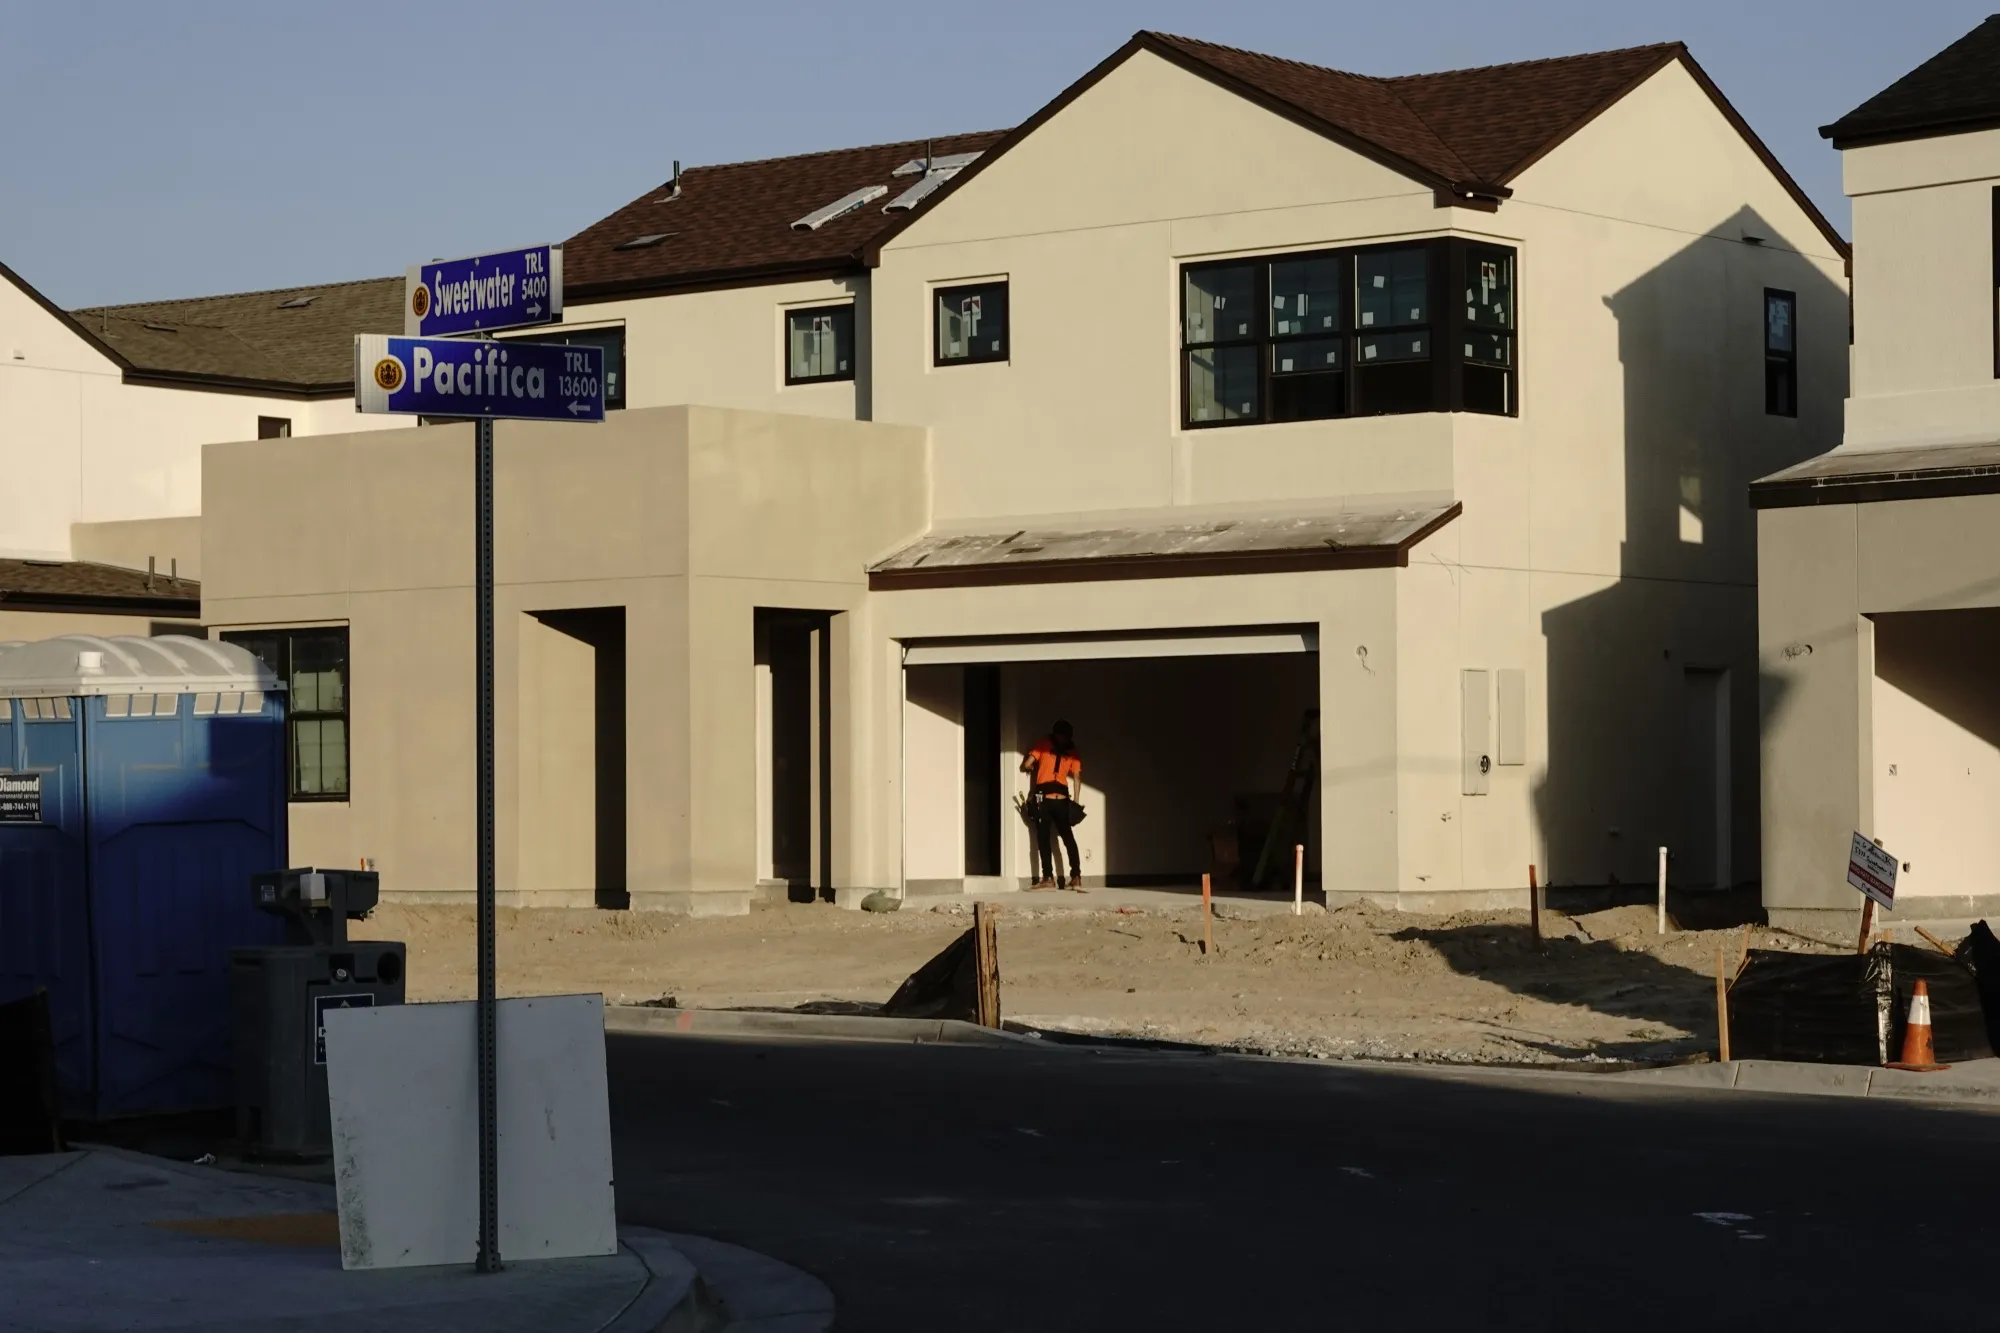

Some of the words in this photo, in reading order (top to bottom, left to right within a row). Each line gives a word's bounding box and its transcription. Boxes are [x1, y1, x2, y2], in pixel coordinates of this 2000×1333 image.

[524, 252, 544, 274] TRL
[434, 266, 515, 317] Sweetwater
[521, 275, 547, 300] 5400
[413, 346, 546, 399] Pacifica
[564, 352, 592, 373] TRL
[558, 376, 598, 398] 13600
